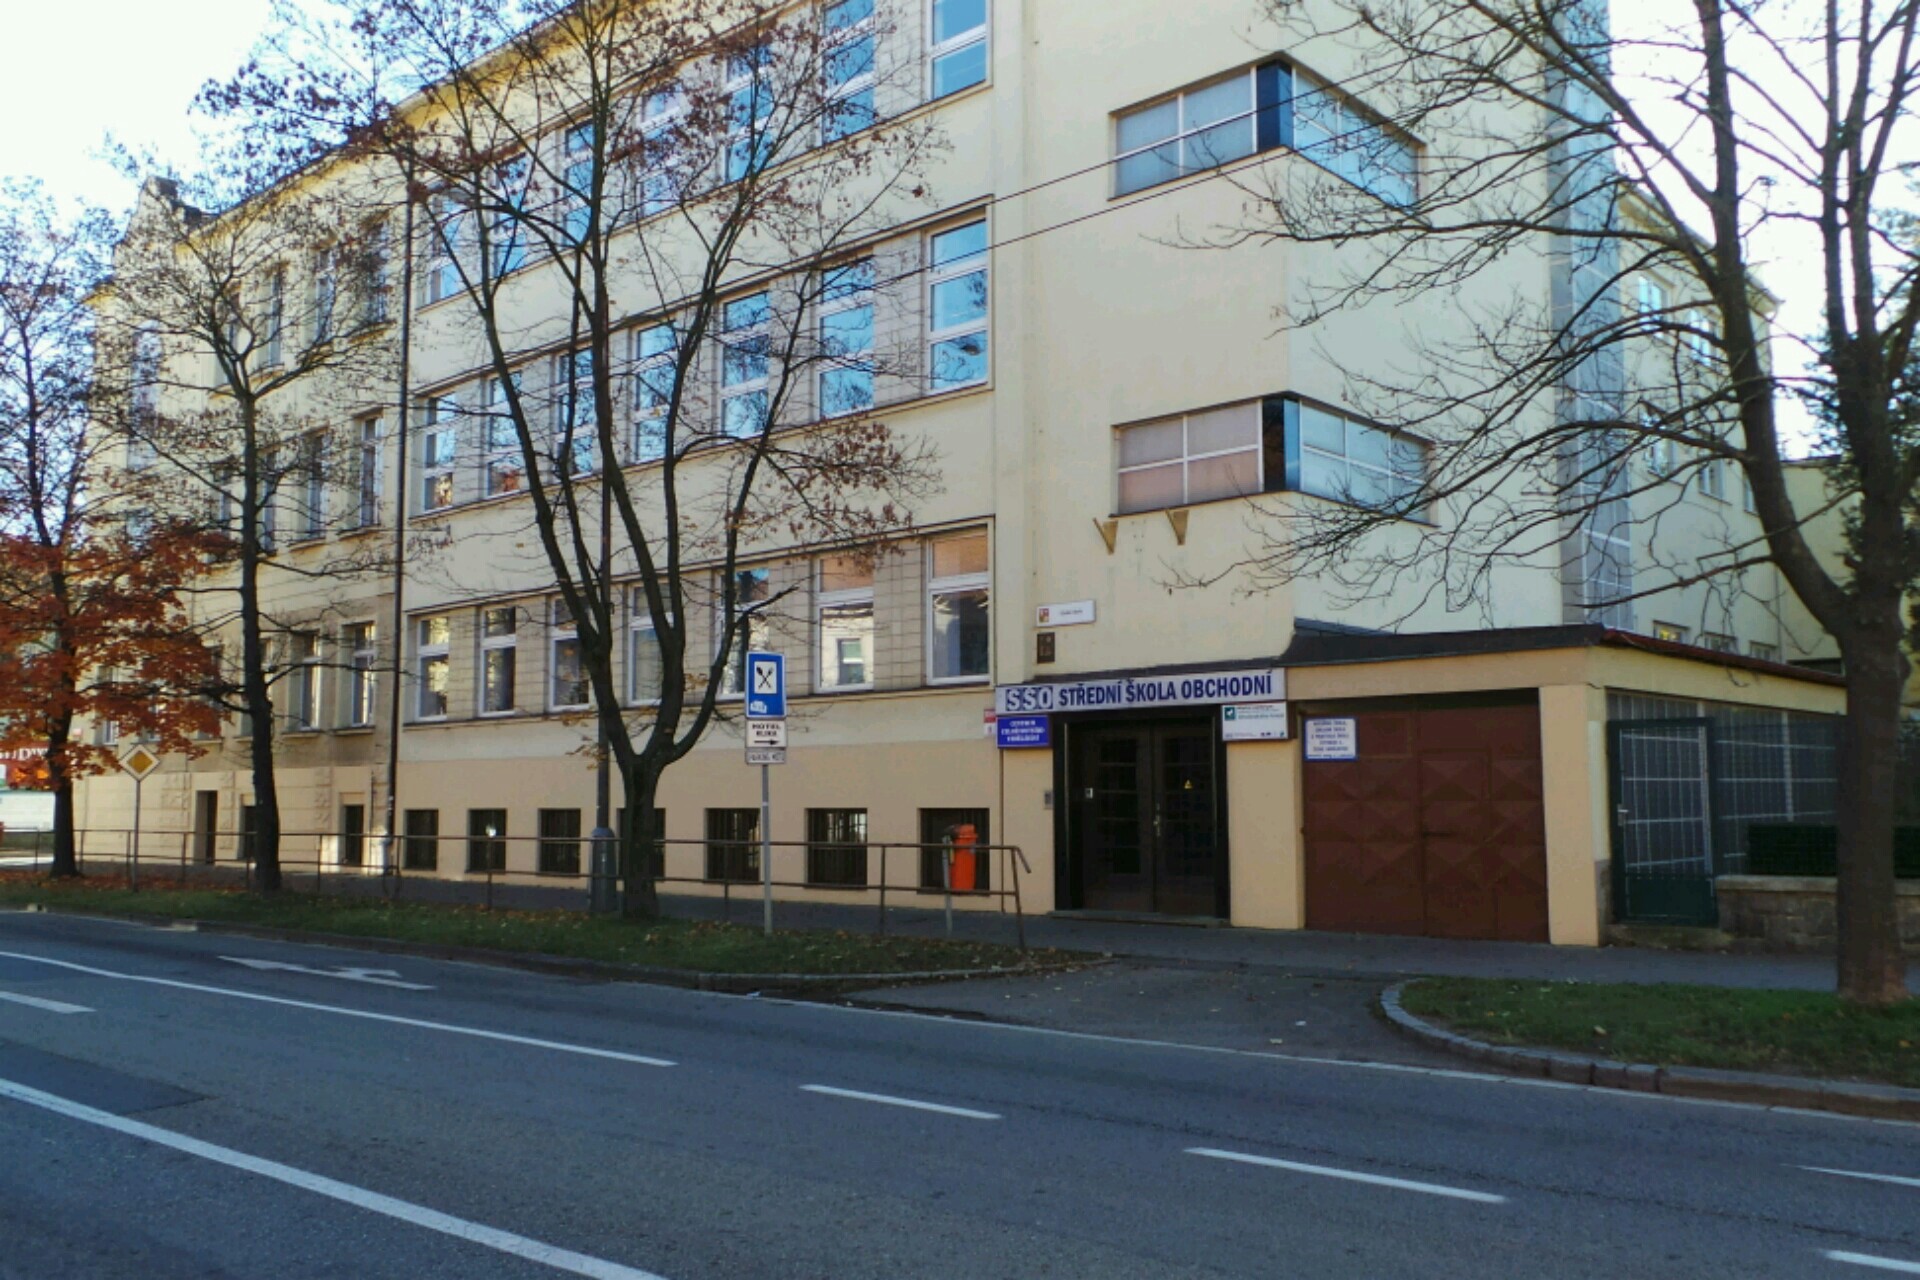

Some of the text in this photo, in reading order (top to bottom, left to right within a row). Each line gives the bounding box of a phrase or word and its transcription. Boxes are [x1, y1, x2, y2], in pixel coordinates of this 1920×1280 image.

[1059, 682, 1122, 706] STŘEDNÍ
[1125, 680, 1176, 702] ŠKOLA
[1181, 671, 1272, 699] OBCHODNÍ
